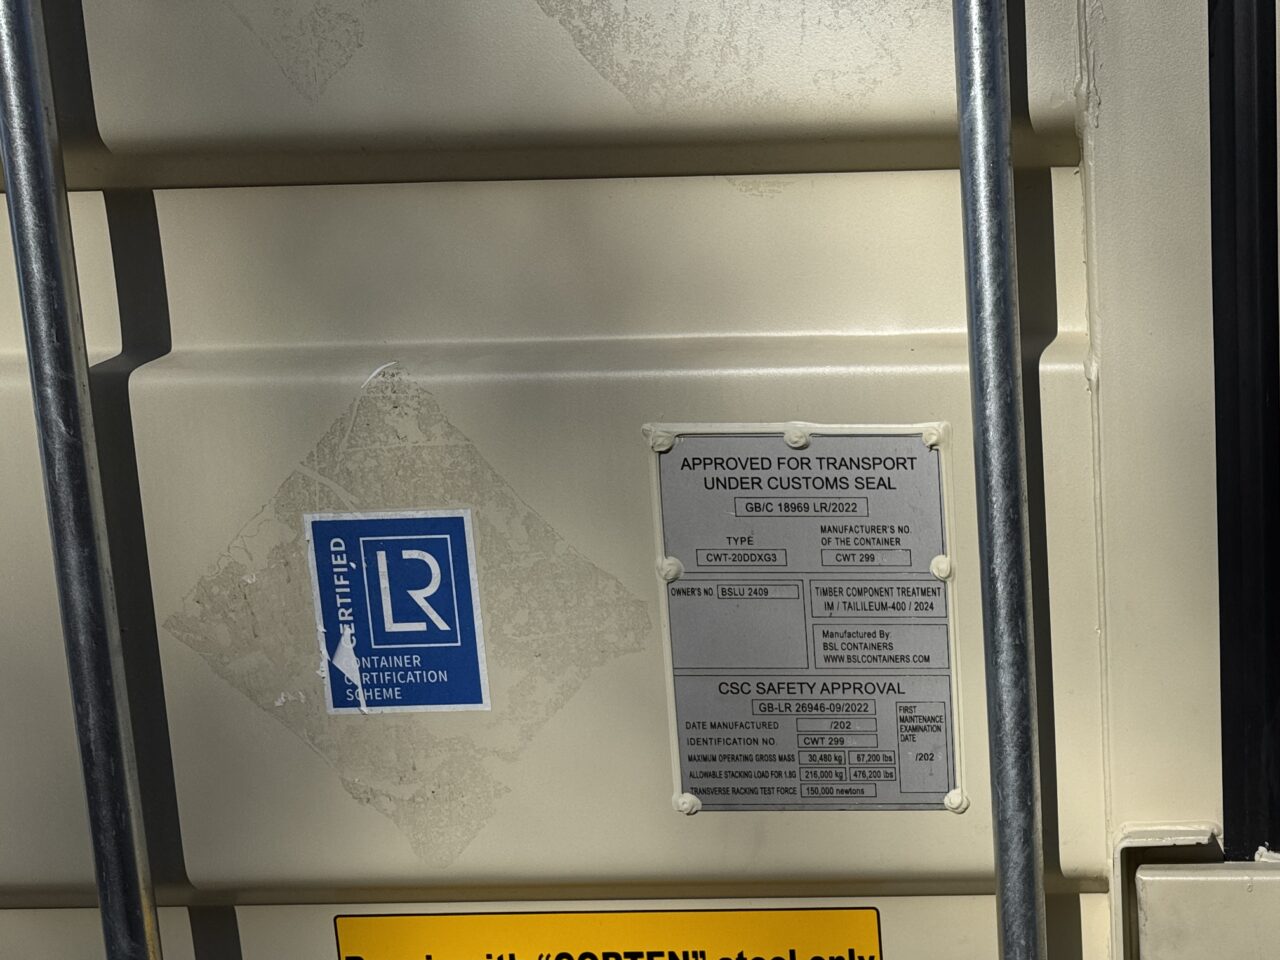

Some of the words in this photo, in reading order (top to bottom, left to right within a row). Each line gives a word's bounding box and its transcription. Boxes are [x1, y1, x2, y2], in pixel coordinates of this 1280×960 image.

[680, 457, 772, 471] APPROVED
[777, 457, 812, 471] FOR
[816, 457, 917, 471] TRANSPORT
[703, 476, 763, 490] UNDER
[767, 476, 849, 490] CUSTOMS
[854, 476, 897, 490] SEAL
[745, 502, 774, 513] GB/C
[777, 502, 810, 513] 18969
[813, 502, 858, 513] LR/2022
[820, 525, 895, 534] MANUFACTURER'S
[726, 536, 754, 546] TYPE
[821, 537, 832, 546] OF
[835, 537, 851, 546] THE
[853, 537, 901, 546] CONTAINER
[706, 553, 777, 562] CWT-20DDXG3
[835, 553, 857, 562] CWT
[859, 553, 875, 562] 299
[376, 549, 451, 632] LR
[670, 587, 702, 597] OWNER'S
[721, 587, 745, 597] BSLU
[748, 587, 769, 597] 2409
[815, 586, 844, 597] TIMBER
[846, 586, 894, 597] COMPONENT
[896, 586, 942, 597] TREATMENT
[914, 601, 934, 611] 2024
[822, 630, 877, 639] Manufactured
[823, 642, 839, 651] BSL
[841, 642, 894, 651] CONTAINERS
[344, 670, 448, 686] CRTIFICATION
[718, 682, 752, 695] CSC
[756, 682, 816, 695] SAFETY
[820, 682, 906, 694] APPROVAL
[758, 702, 792, 713] GB-LR
[795, 702, 869, 713] 26946-09/2022
[899, 706, 917, 714] FIRST
[899, 715, 944, 724] MAINTENANCE
[685, 721, 708, 730] DATE
[710, 721, 779, 730] MANUFACTURED
[830, 721, 852, 730] /202
[900, 725, 942, 733] EXAMINATION
[687, 737, 759, 746] IDENTIFICATION
[803, 737, 825, 746] CWT
[828, 737, 845, 746] 299
[900, 735, 916, 743] DATE
[688, 754, 717, 763] MAXIMUM
[718, 754, 754, 763] OPERATING
[755, 754, 777, 763] GROSS
[778, 754, 796, 763] MASS
[808, 754, 833, 764] 30,480
[833, 753, 843, 765] kg
[882, 753, 893, 763] lbs
[915, 752, 935, 762] /202
[689, 770, 723, 779] ALLOWABLE
[724, 770, 753, 779] STACKING
[753, 770, 770, 779] LOAD
[770, 770, 783, 779] FOR
[835, 770, 844, 781] kg
[883, 770, 894, 780] lbs
[690, 787, 730, 796] TRANSVERSE
[760, 787, 777, 796] TEST
[777, 787, 797, 796] FORCE
[806, 787, 834, 796] 150,000
[835, 787, 865, 796] newtons
